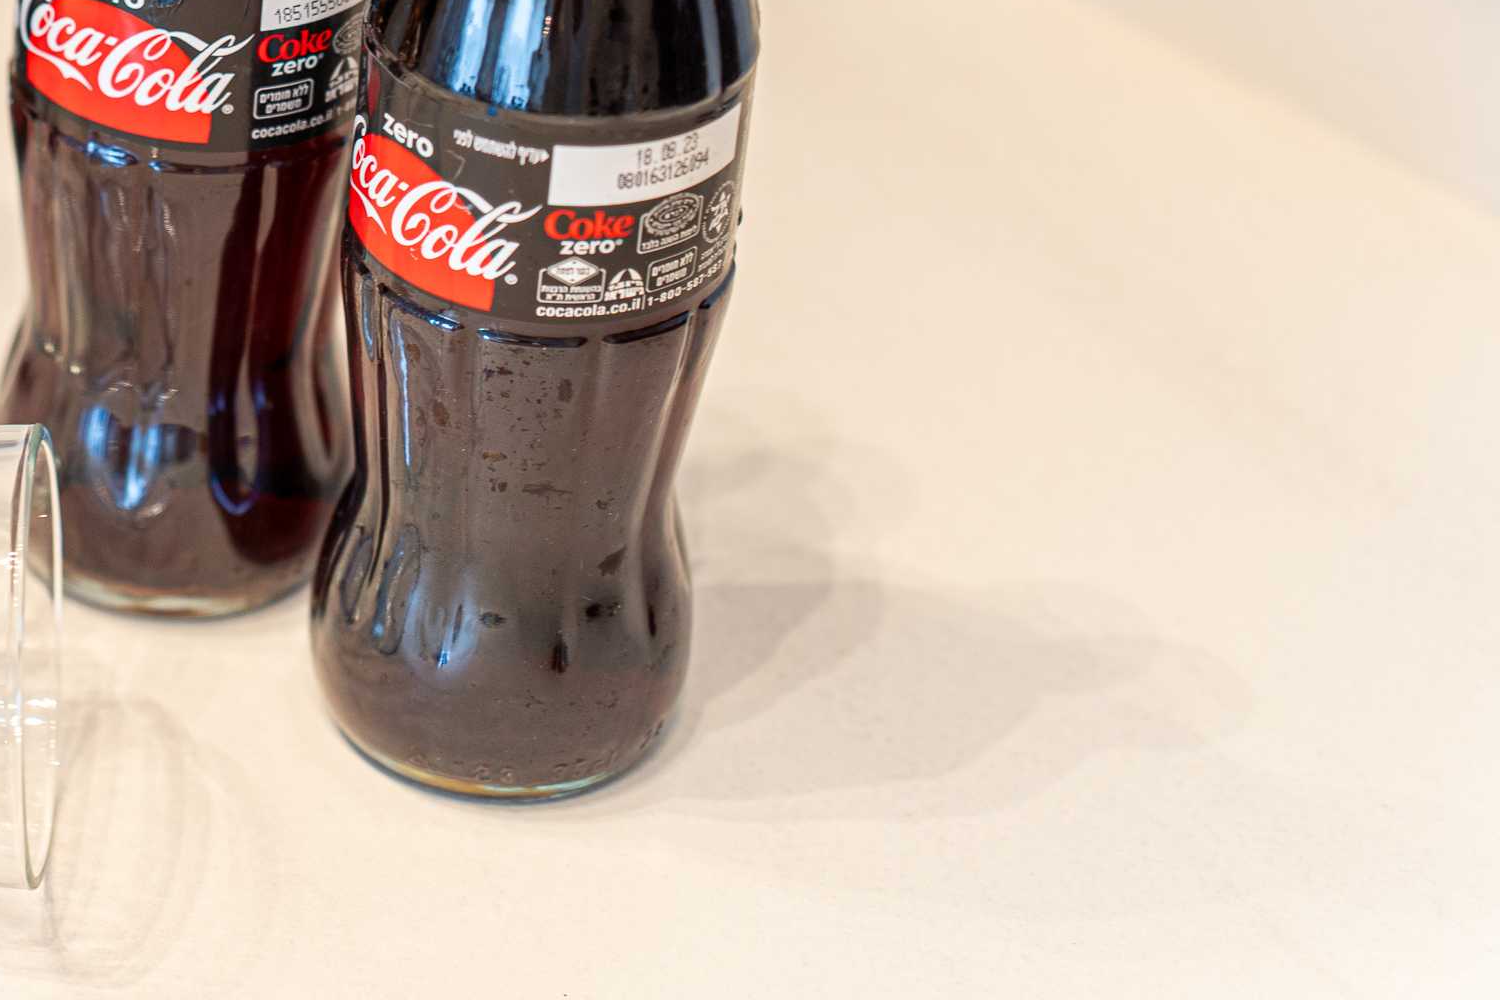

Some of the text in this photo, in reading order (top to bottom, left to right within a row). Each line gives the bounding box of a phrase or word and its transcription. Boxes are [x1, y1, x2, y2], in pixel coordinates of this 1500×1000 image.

[257, 28, 333, 64] Coke
[271, 55, 318, 77] zero
[382, 112, 434, 158] zero
[543, 209, 635, 240] Coke
[558, 239, 616, 256] zero
[536, 298, 641, 317] cocacola.co.il
